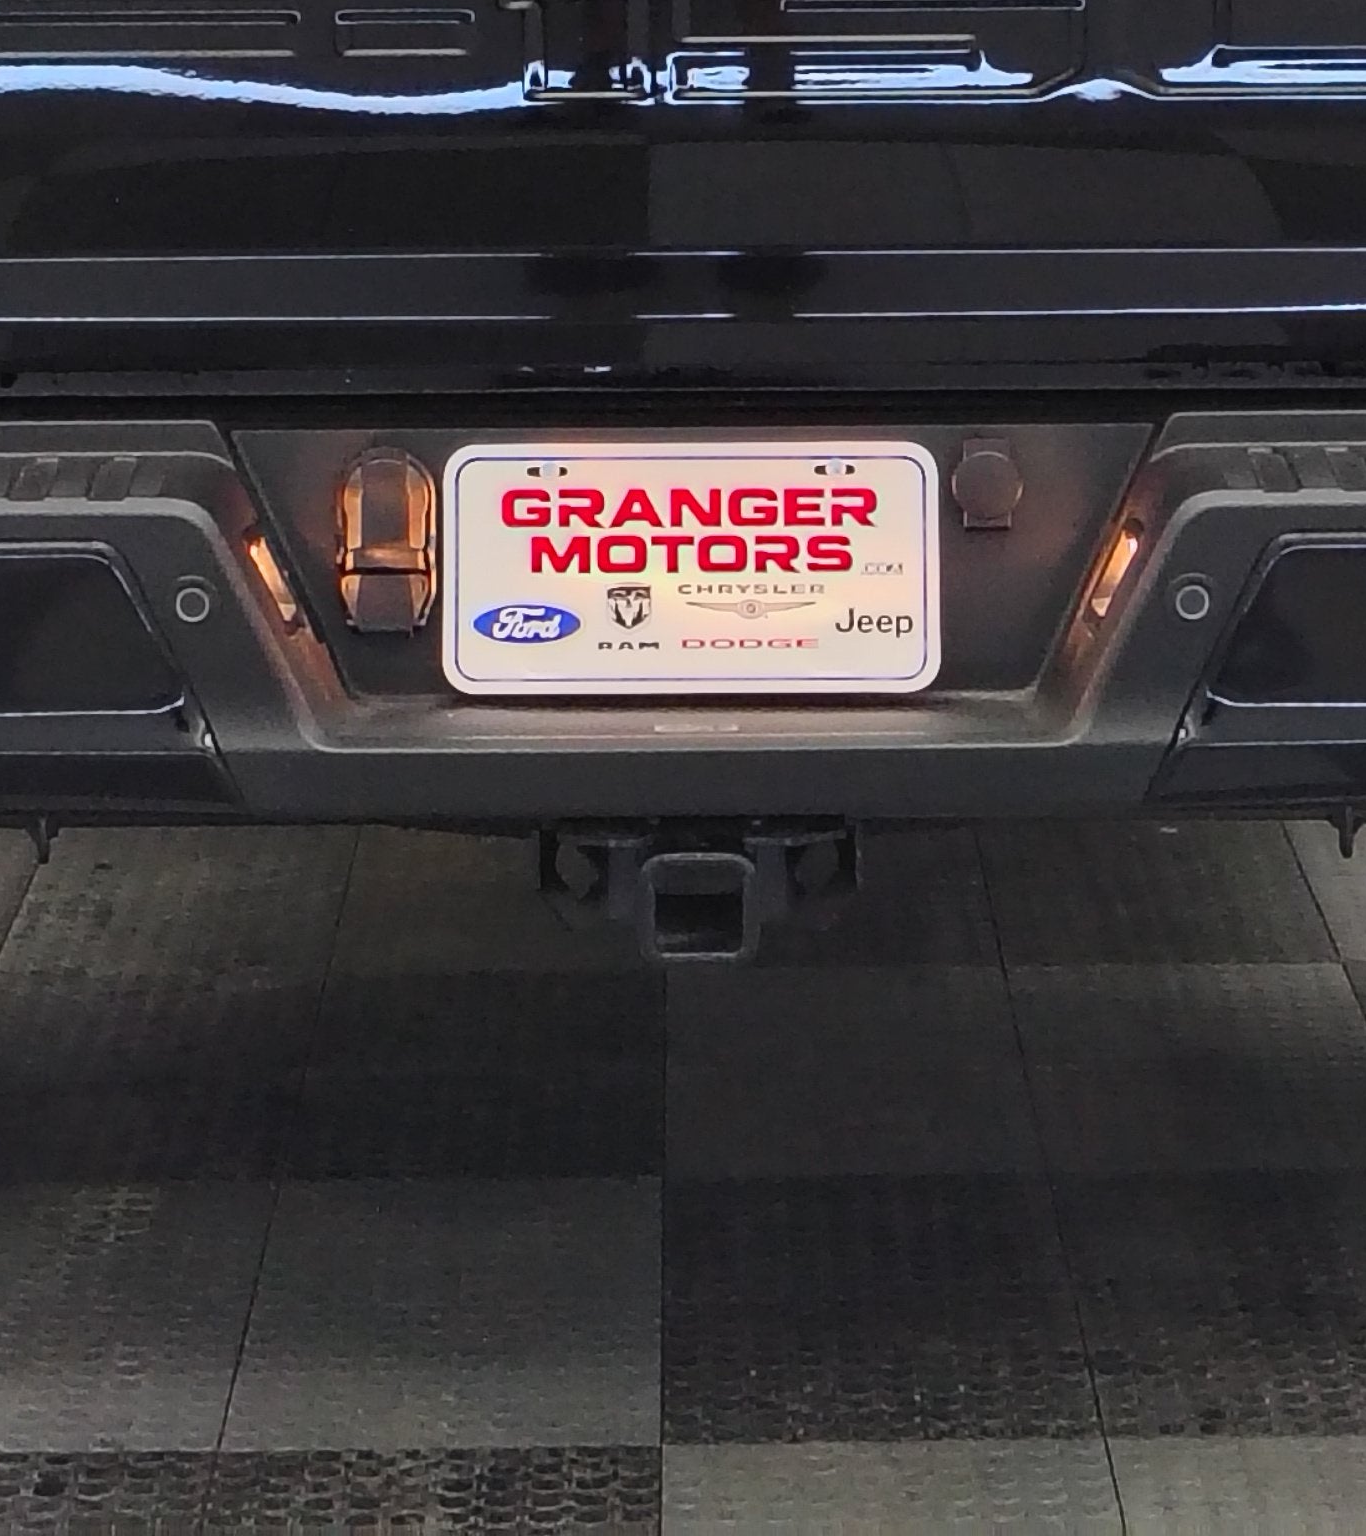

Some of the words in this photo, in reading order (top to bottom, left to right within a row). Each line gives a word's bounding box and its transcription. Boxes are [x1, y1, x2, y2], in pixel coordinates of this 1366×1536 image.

[500, 487, 878, 529] GRANGER
[530, 534, 854, 575] MOTORS
[677, 583, 826, 595] CHRYSLER
[491, 606, 563, 640] Ford
[834, 607, 914, 639] Jeep
[597, 641, 661, 651] RAM
[681, 638, 819, 650] DODGE
